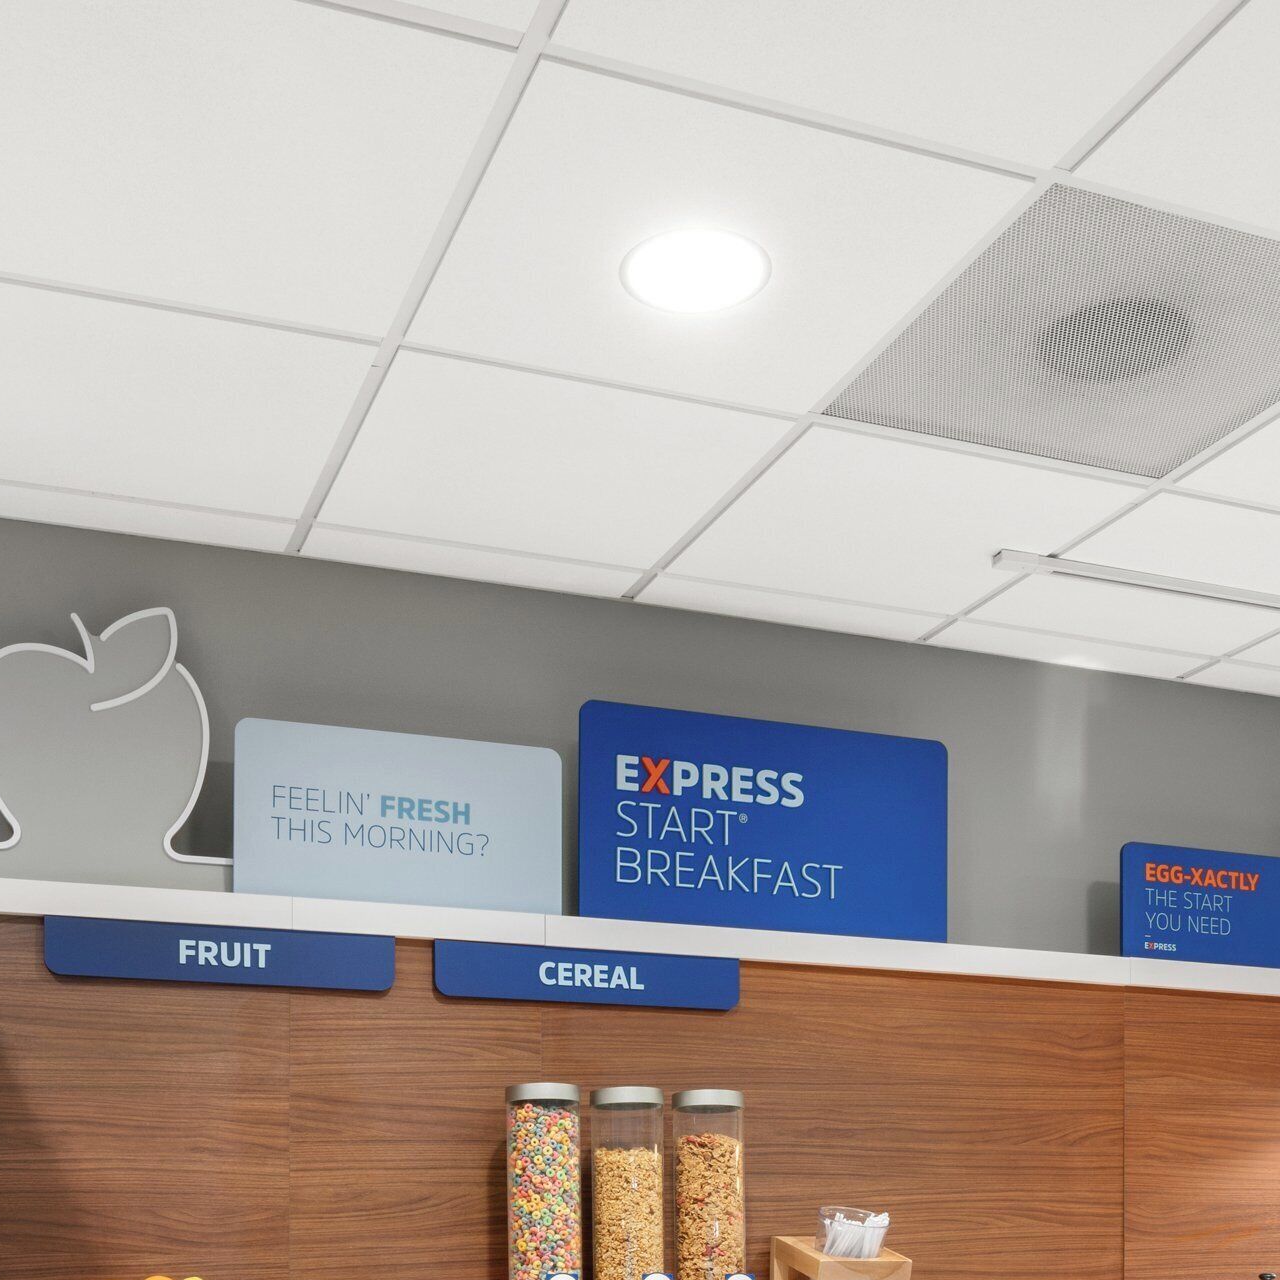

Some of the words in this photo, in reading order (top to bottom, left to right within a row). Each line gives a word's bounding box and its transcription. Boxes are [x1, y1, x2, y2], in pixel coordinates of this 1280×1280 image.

[616, 754, 805, 808] EXPRESS
[380, 794, 471, 825] FRESH
[271, 816, 332, 844] THIS
[344, 822, 490, 857] MORNING?
[616, 846, 844, 900] BREAKFAST
[1145, 863, 1259, 891] EGG-XACTLY
[1145, 888, 1177, 908] THE
[1183, 892, 1233, 912] START
[1145, 912, 1181, 932] YOU
[1188, 915, 1231, 935] NEED
[179, 939, 272, 969] FRUIT
[1144, 942, 1177, 951] EXPRESS
[538, 961, 645, 991] CEREAL
